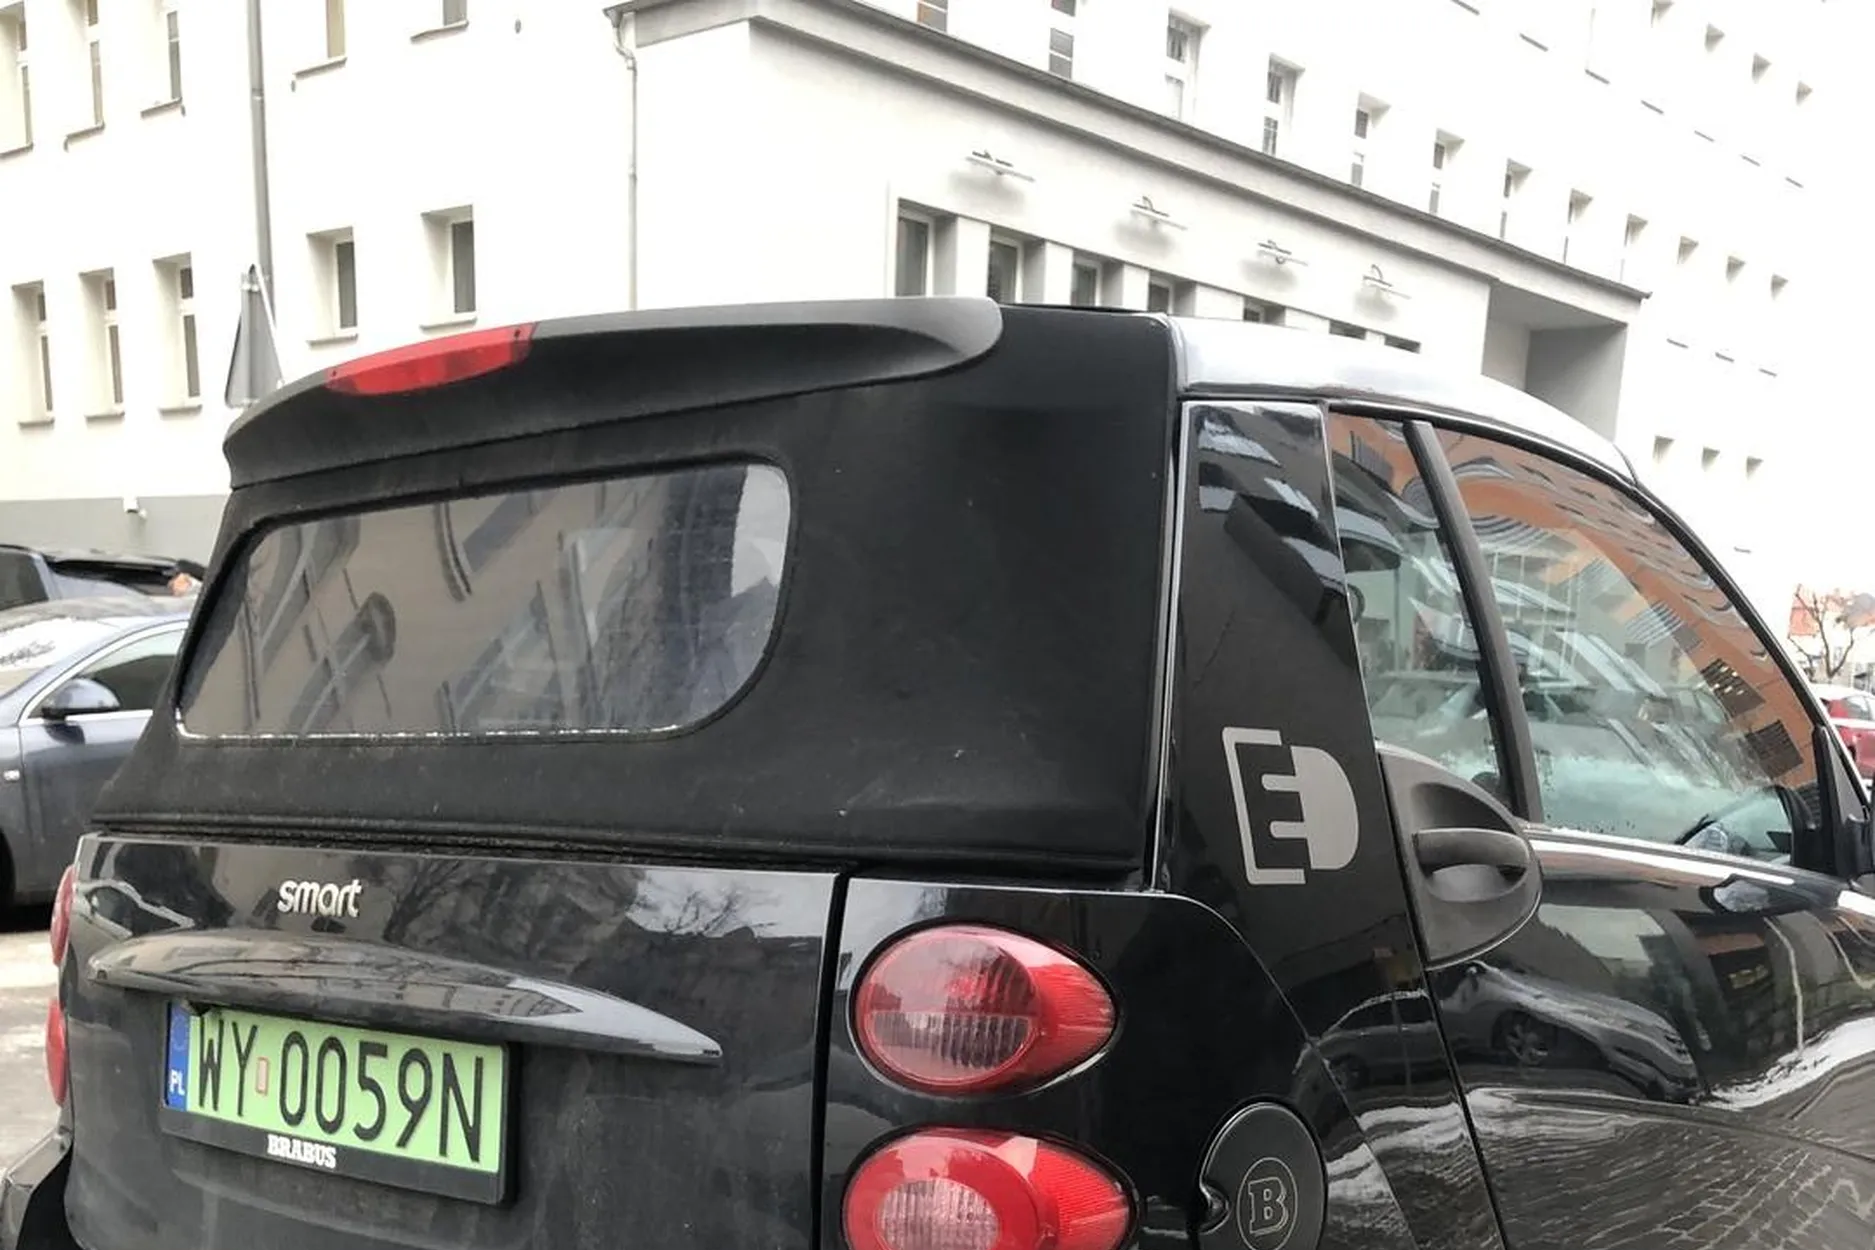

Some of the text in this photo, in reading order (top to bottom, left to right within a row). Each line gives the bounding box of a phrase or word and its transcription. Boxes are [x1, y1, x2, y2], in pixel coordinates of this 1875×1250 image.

[277, 879, 362, 918] smart
[169, 1068, 185, 1096] PL
[199, 1014, 484, 1163] WY 0059N
[267, 1133, 337, 1169] BRABUS
[1248, 1176, 1289, 1237] B
